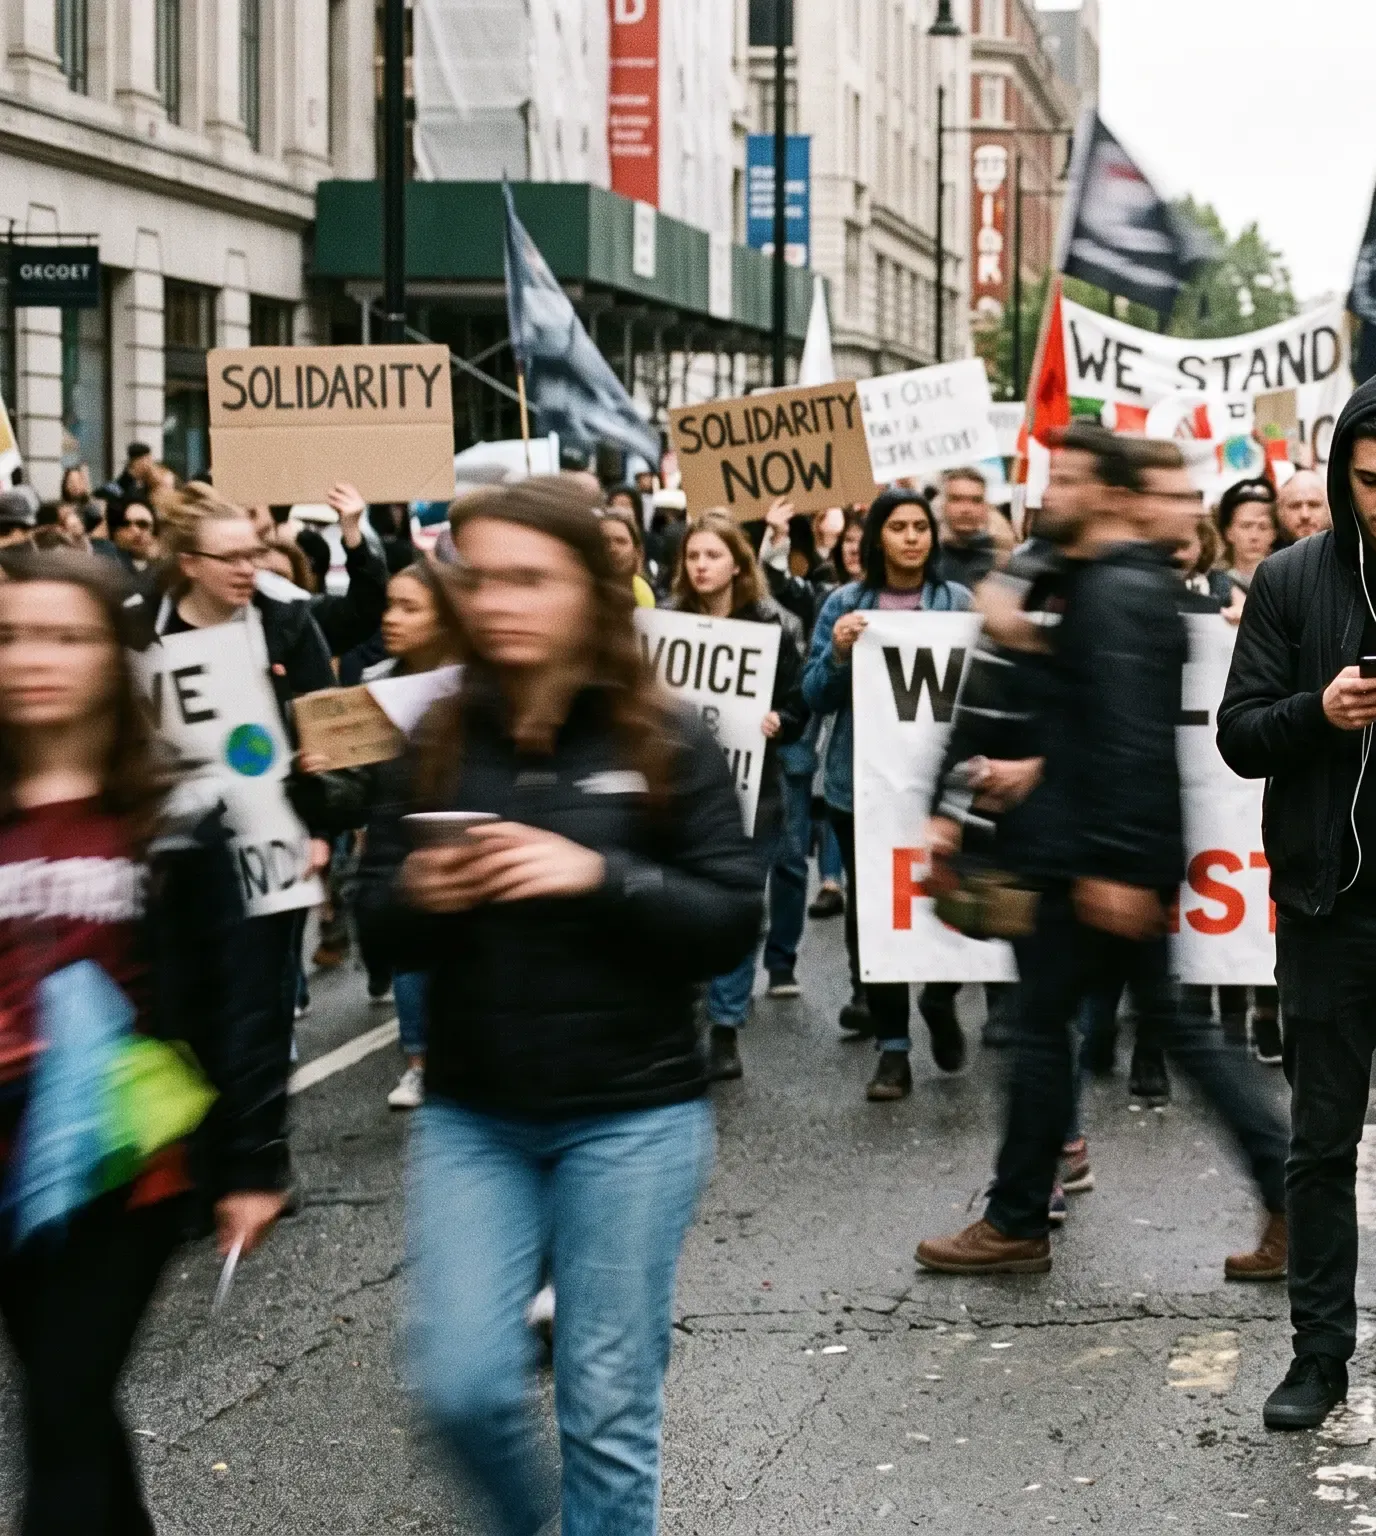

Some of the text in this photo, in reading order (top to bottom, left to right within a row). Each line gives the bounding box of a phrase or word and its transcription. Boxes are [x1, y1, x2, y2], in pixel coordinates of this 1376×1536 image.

[222, 363, 442, 411] SOLIDARITY
[1069, 319, 1342, 395] WE STAND
[678, 391, 858, 455] SOLIDARITY
[720, 442, 833, 503] NOW
[640, 632, 763, 698] VOICE
